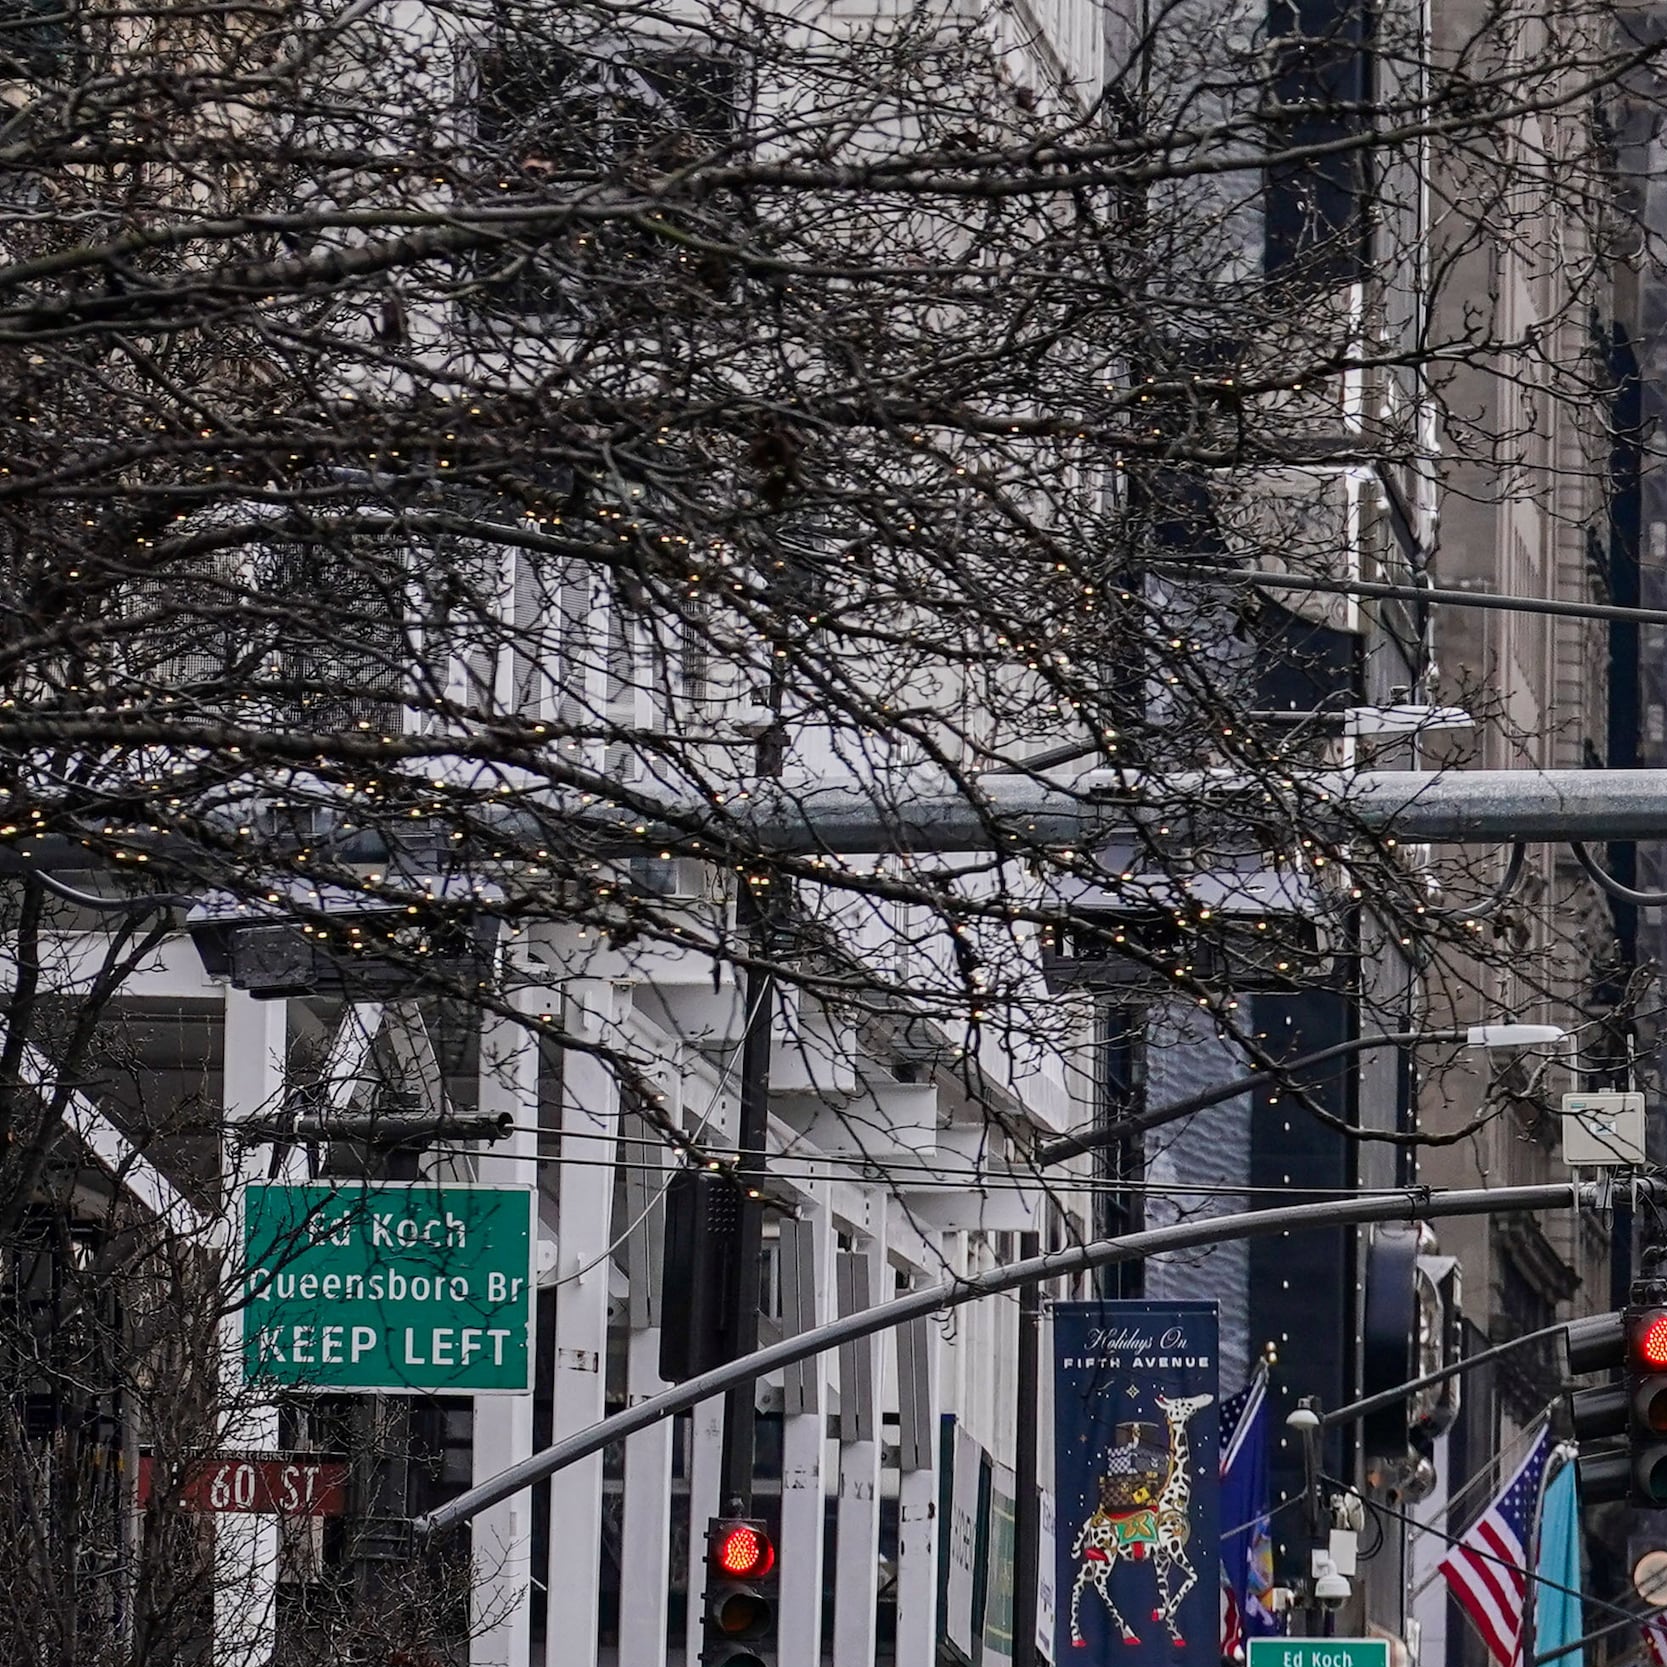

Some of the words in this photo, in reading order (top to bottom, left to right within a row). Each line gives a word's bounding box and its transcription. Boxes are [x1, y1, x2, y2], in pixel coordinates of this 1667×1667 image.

[309, 1210, 351, 1246] Ed
[372, 1212, 466, 1248] Koch
[252, 1267, 469, 1301] Queensboro
[488, 1271, 523, 1302] Br
[259, 1325, 377, 1363] KEEP
[405, 1327, 511, 1365] LEFT
[1084, 1327, 1153, 1355] Holidays
[1160, 1327, 1188, 1349] On
[1064, 1358, 1121, 1369] FIFTH
[1133, 1357, 1209, 1368] AVENUE
[210, 1463, 255, 1508] 60
[279, 1465, 319, 1510] ST
